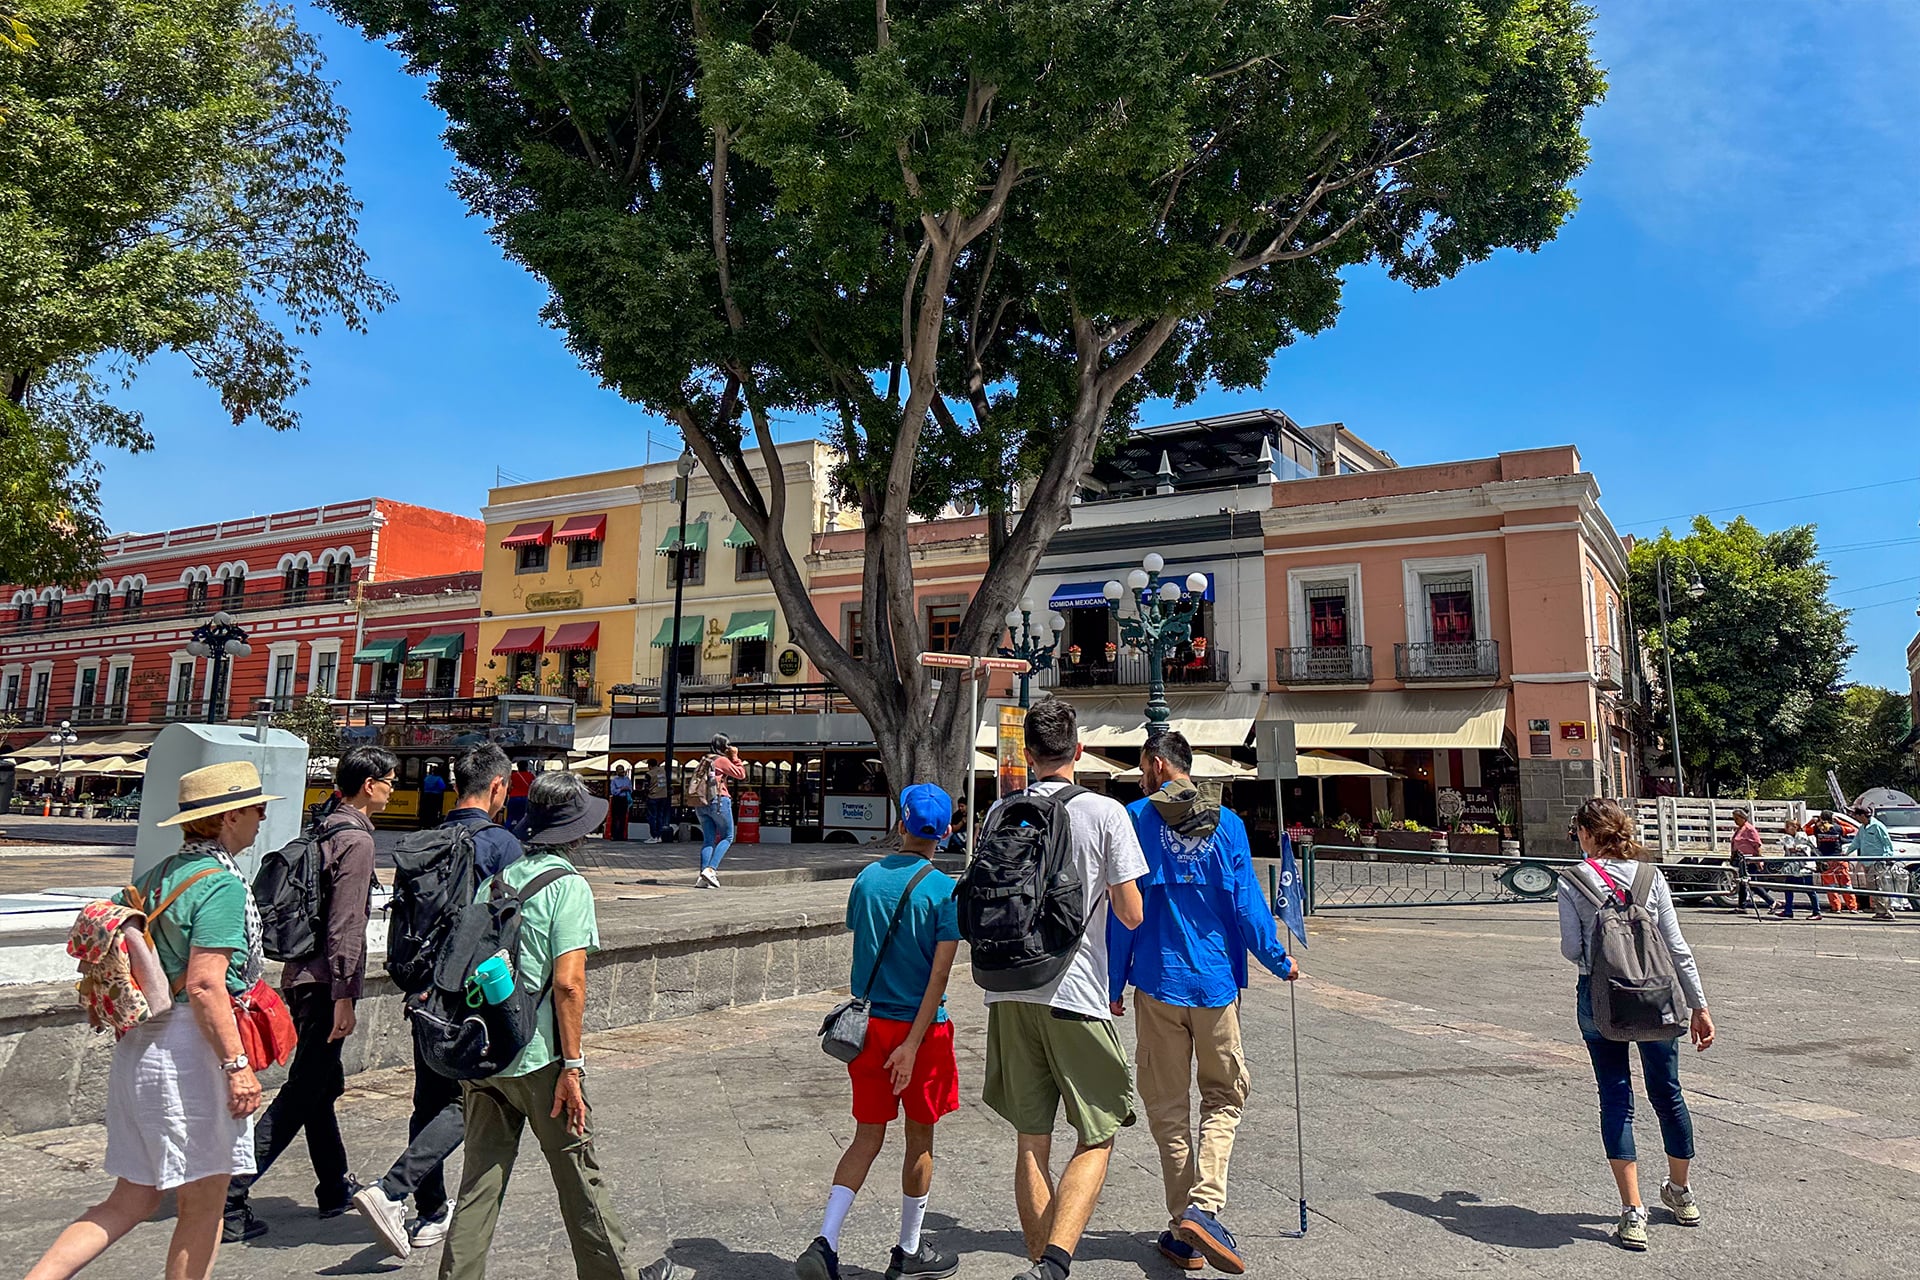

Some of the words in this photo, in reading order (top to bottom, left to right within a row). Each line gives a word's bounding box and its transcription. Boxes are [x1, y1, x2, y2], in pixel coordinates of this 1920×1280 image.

[1050, 600, 1073, 608] COMIDA
[1074, 598, 1107, 606] MEXICANA
[1466, 793, 1474, 802] El
[1476, 794, 1487, 802] Sol
[1470, 805, 1494, 814] Puebla
